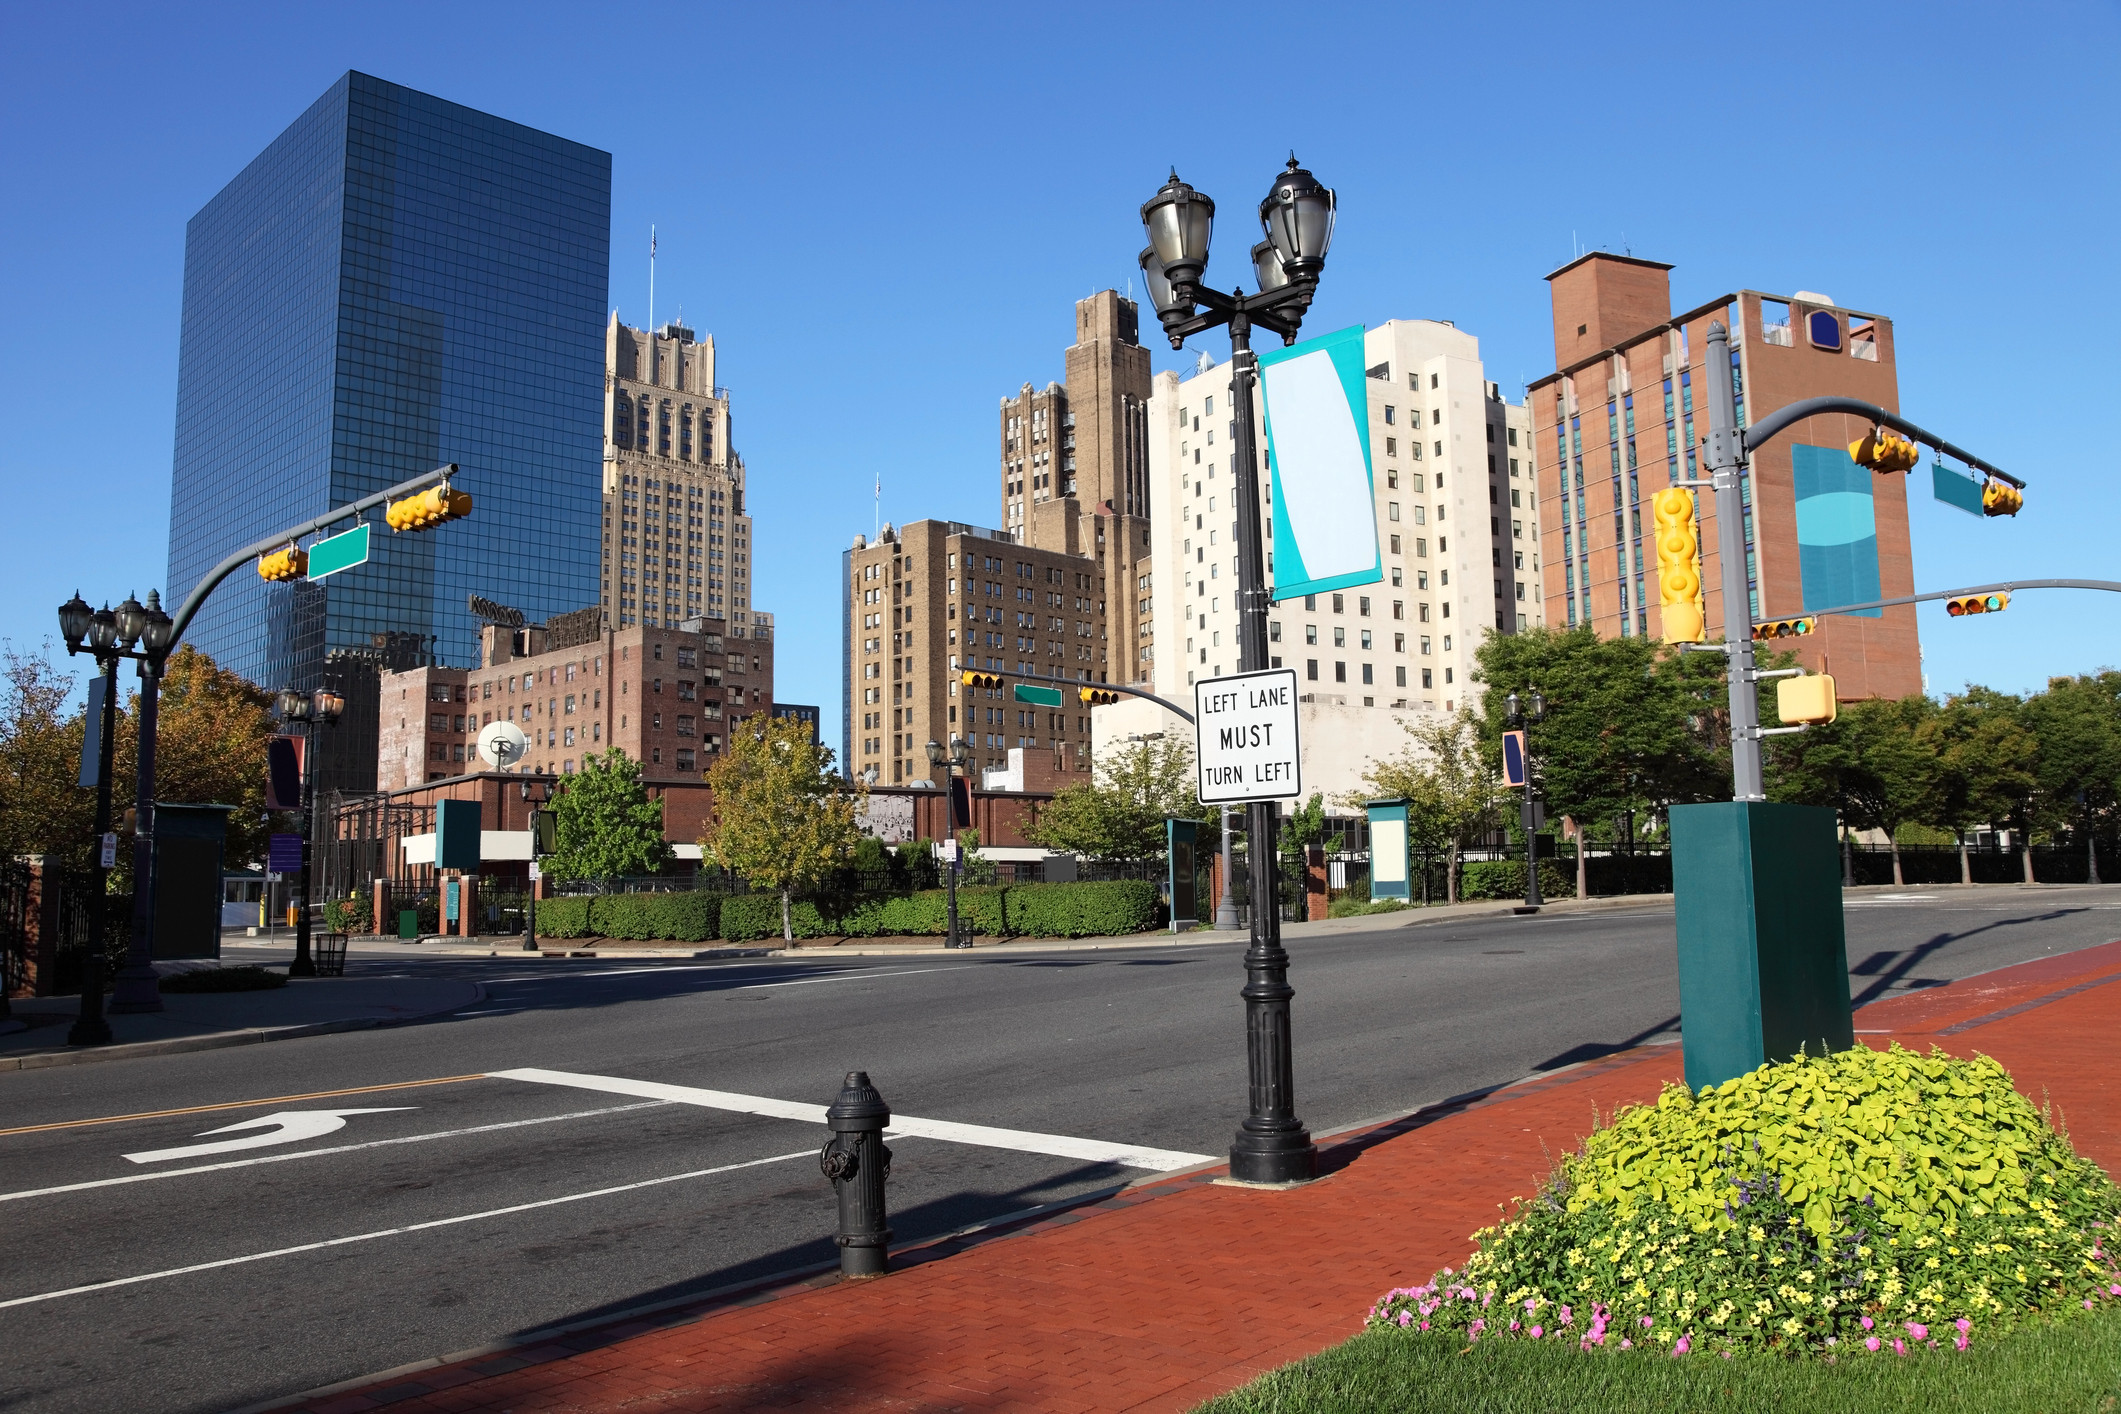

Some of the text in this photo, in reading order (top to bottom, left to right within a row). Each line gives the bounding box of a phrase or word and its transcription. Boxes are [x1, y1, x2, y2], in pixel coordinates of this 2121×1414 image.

[1205, 687, 1288, 714] LEFT LANE
[1220, 723, 1273, 750] MUST
[1205, 761, 1291, 786] TURN LEFT
